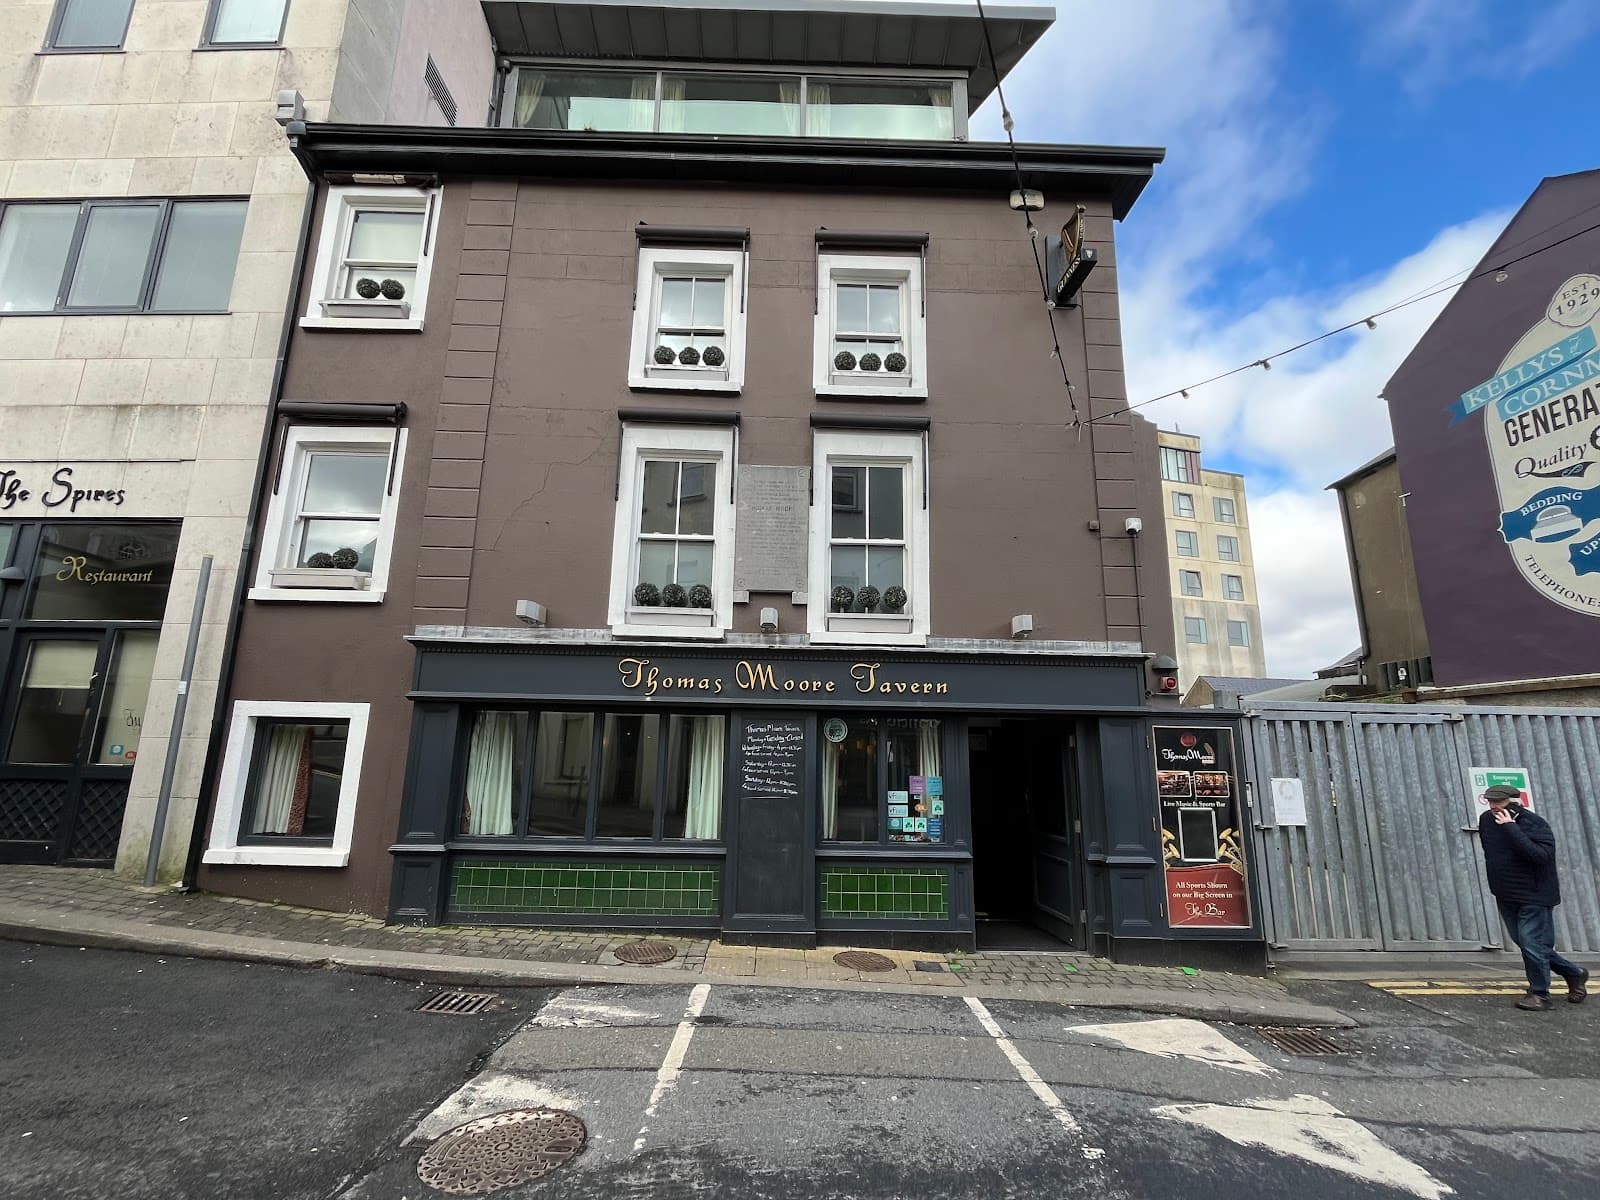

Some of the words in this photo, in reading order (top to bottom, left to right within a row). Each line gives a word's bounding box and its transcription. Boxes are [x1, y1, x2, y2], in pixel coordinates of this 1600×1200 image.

[1556, 287, 1600, 315] 1929
[1562, 281, 1589, 300] EST
[1466, 347, 1564, 409] KELLYS
[1504, 382, 1600, 447] GENERA
[1515, 443, 1588, 478] Quality
[41, 467, 126, 512] Spires
[1521, 491, 1583, 517] BEDDING
[1580, 537, 1600, 556] UP
[56, 556, 153, 585] Restaurant
[618, 658, 722, 696] Thomas
[735, 660, 836, 693] Moore
[850, 662, 949, 694] Tavern
[1161, 748, 1188, 762] Thomas
[1198, 800, 1216, 809] Sports
[1176, 881, 1186, 889] All
[1186, 881, 1206, 890] Sports
[1207, 881, 1228, 889] Shown
[1193, 891, 1205, 900] Big
[1205, 891, 1226, 899] Screen
[1204, 902, 1226, 916] Bar
